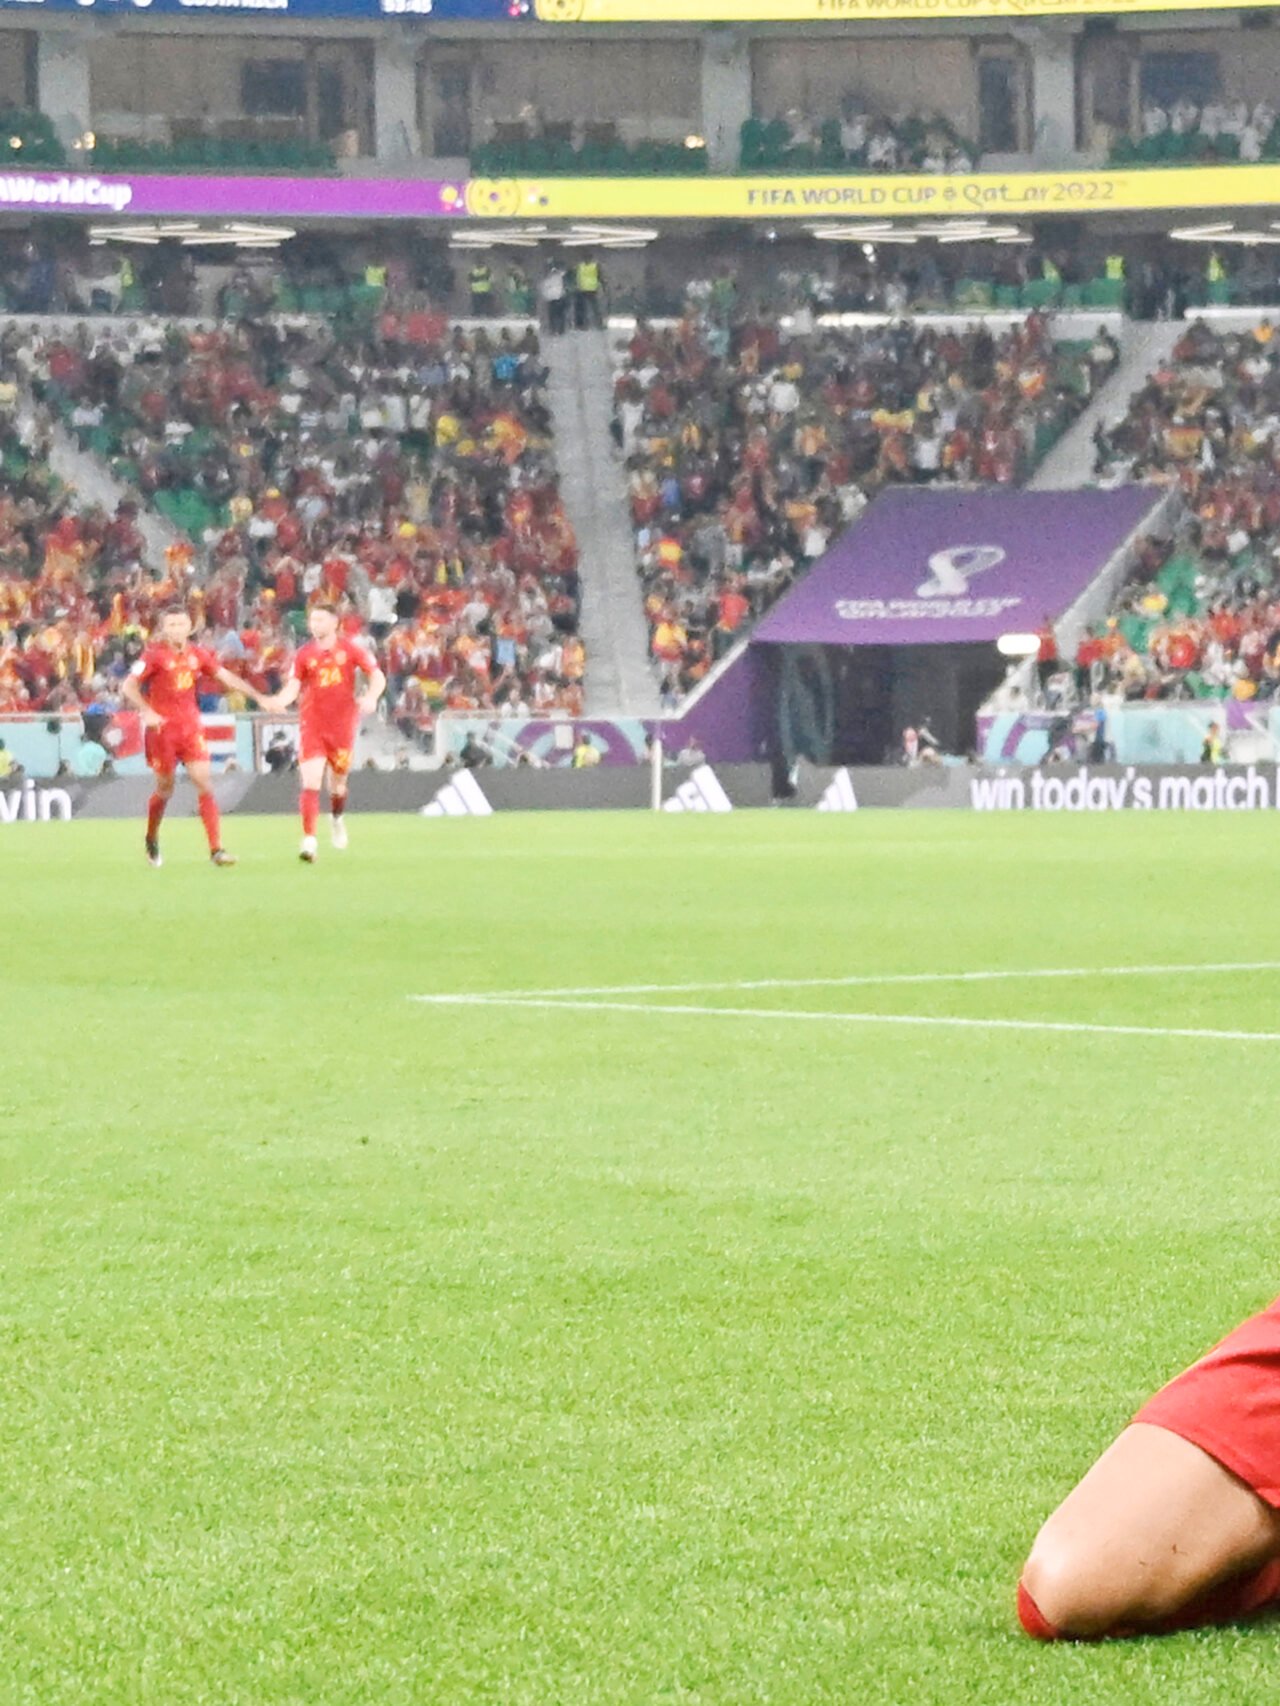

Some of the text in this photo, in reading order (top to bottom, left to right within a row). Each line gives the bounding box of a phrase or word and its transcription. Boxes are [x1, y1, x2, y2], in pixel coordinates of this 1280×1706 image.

[747, 188, 796, 205] FIFA
[802, 186, 887, 205] WORLD
[892, 185, 937, 204] CUP
[319, 667, 342, 688] 24
[970, 768, 1025, 811] win
[1031, 766, 1152, 811] today's
[1158, 765, 1270, 811] match
